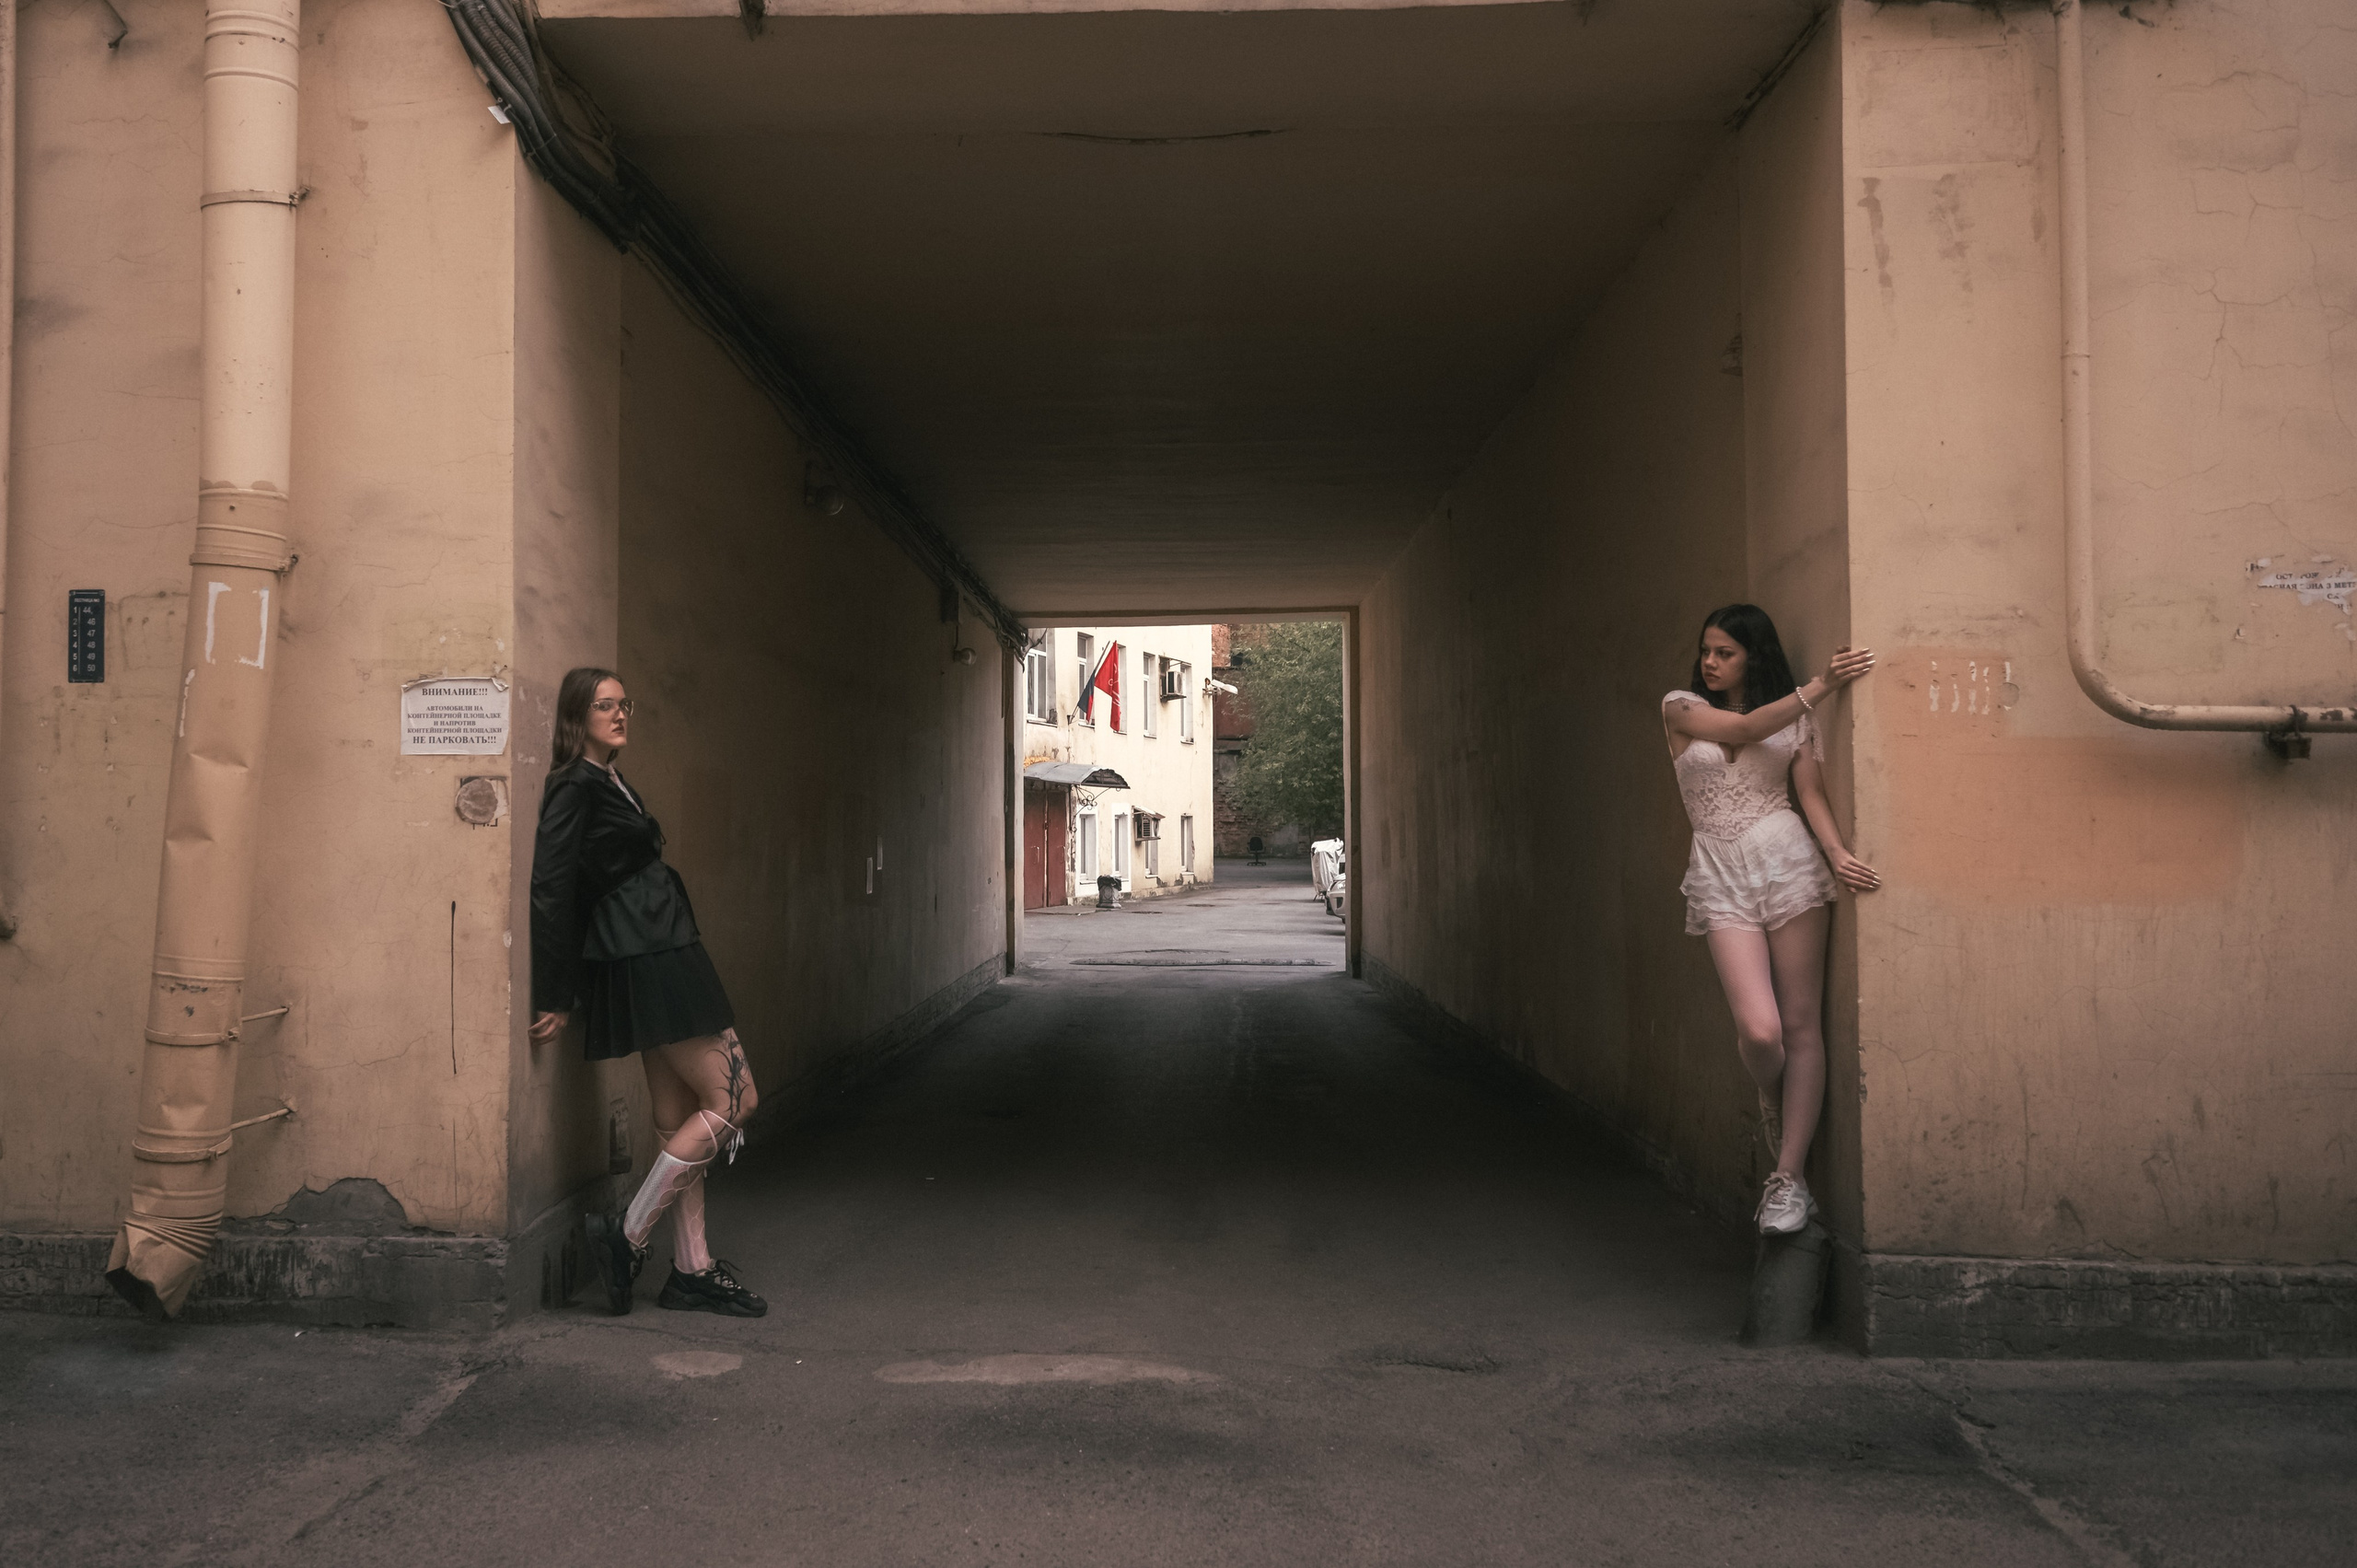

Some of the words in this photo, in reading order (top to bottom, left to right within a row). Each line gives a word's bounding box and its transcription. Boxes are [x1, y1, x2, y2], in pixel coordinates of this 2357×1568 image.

[422, 688, 488, 696] ВНИМАНИЕ!!!
[412, 736, 426, 744] НЕ
[428, 736, 497, 744] ПАРКОВАТЬ!!!
